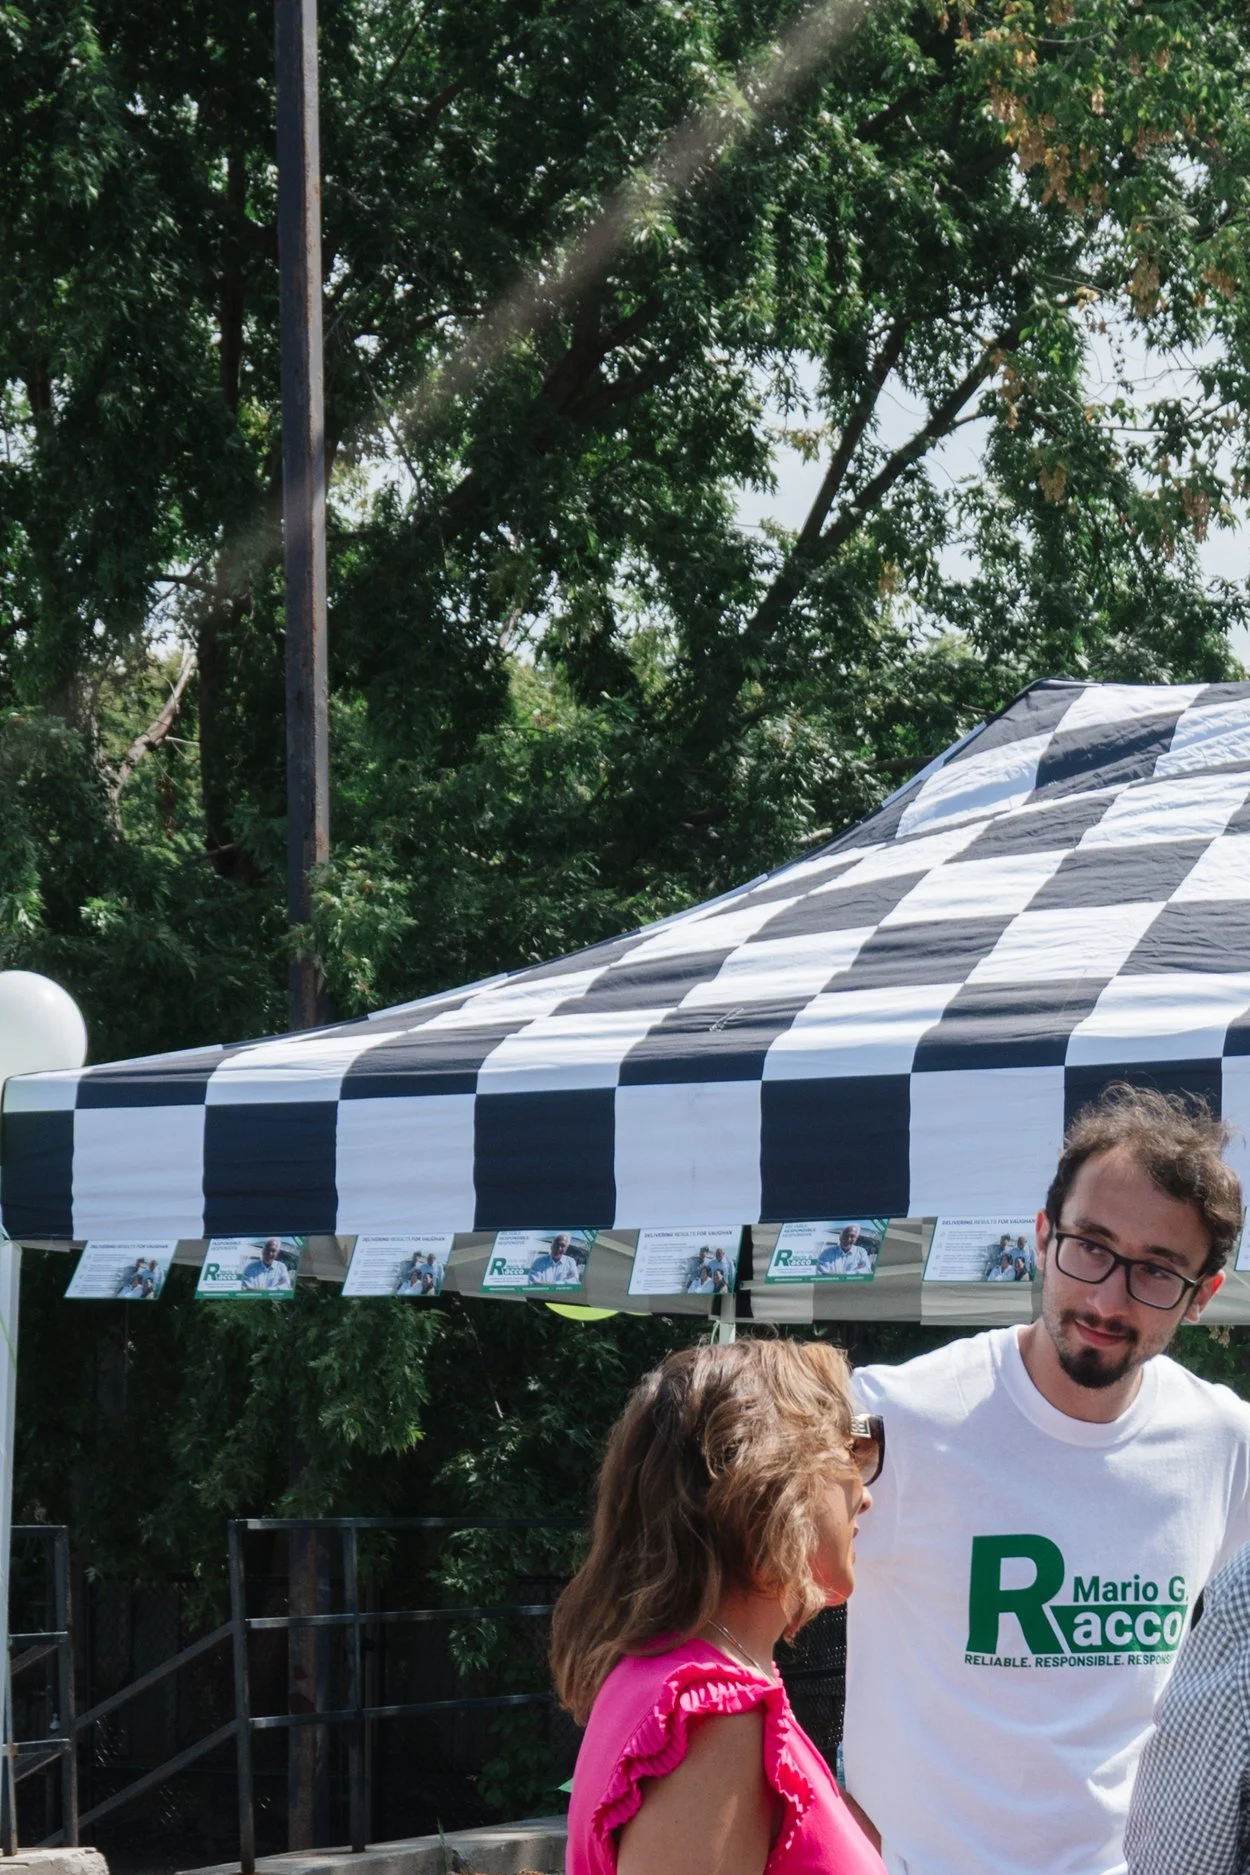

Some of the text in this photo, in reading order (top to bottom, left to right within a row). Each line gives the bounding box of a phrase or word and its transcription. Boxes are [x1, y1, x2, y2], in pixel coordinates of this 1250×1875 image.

[1073, 1574, 1159, 1602] Mario
[965, 1654, 1031, 1668] RELIABLE.
[1035, 1655, 1124, 1668] RESPONSIBLE.
